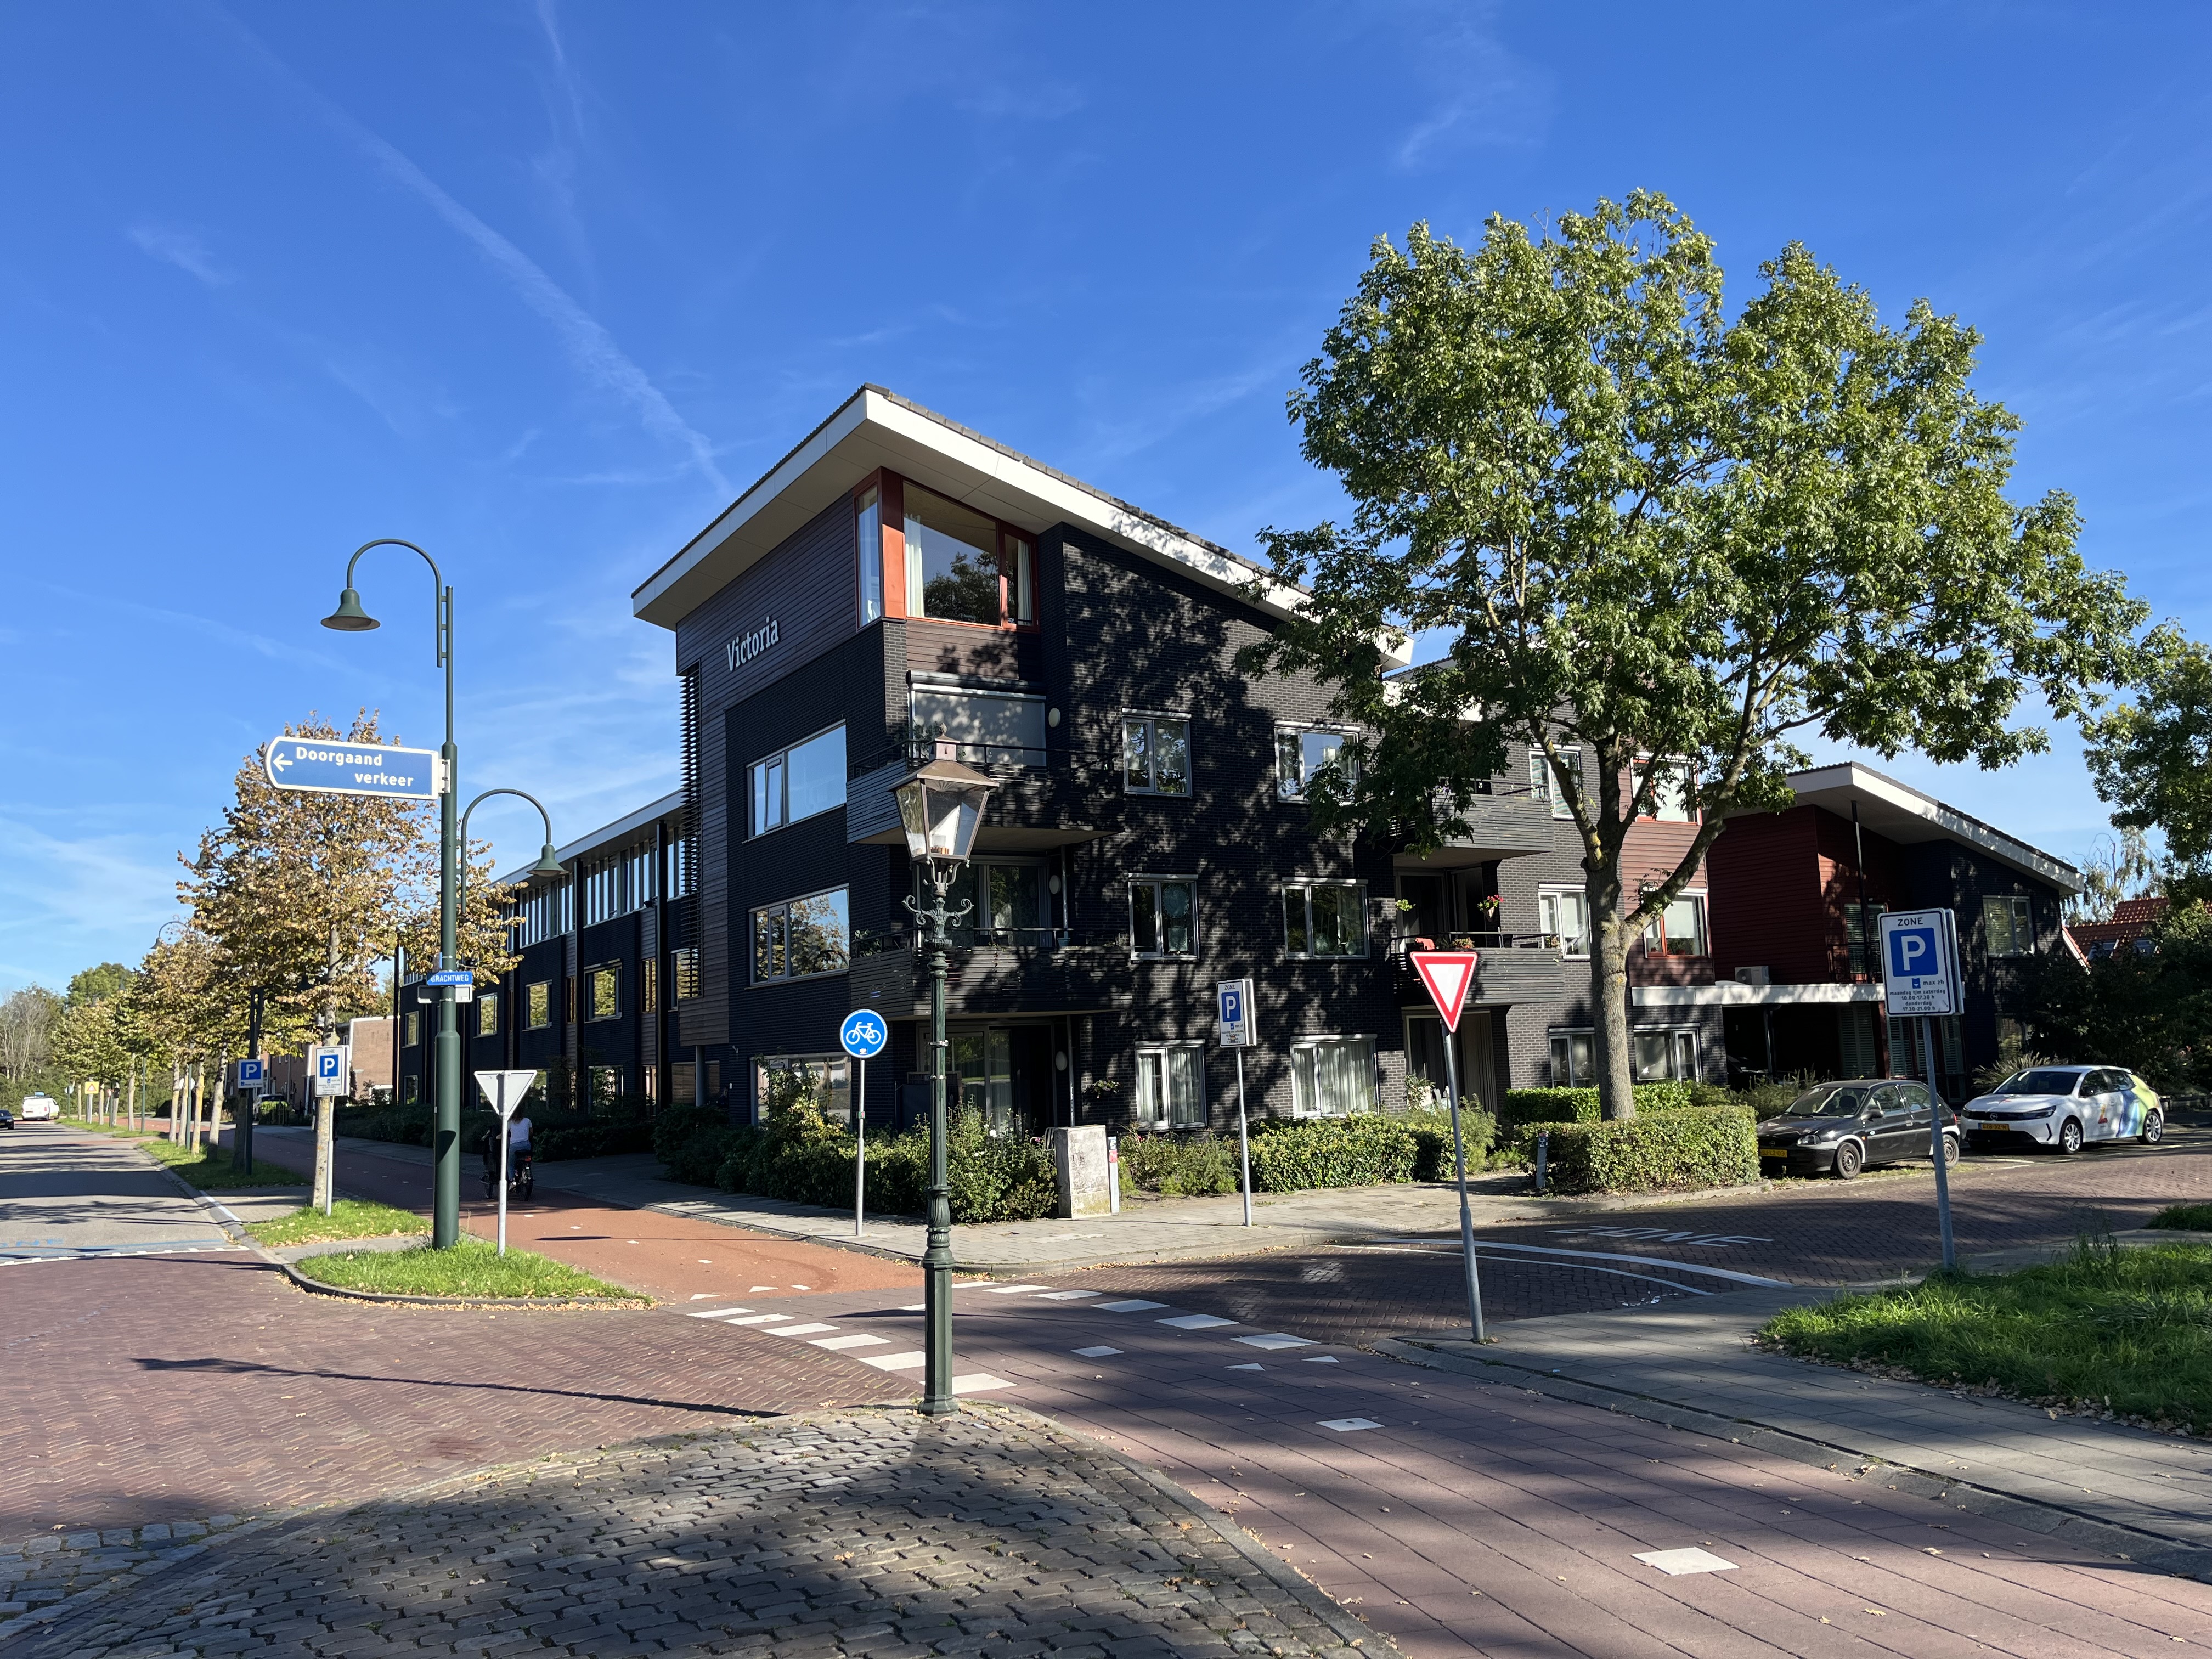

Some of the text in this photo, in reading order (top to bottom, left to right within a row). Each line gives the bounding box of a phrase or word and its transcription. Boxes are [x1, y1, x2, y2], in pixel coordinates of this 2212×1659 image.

[727, 616, 779, 672] Victoria
[296, 747, 382, 766] Doorgaand
[354, 772, 414, 787] verkeer
[1897, 917, 1923, 927] ZONE
[1901, 935, 1926, 971] P
[431, 974, 469, 983] GRACHTWEG
[1226, 996, 1237, 1019] P
[246, 1064, 257, 1078] P
[324, 1057, 335, 1075] P
